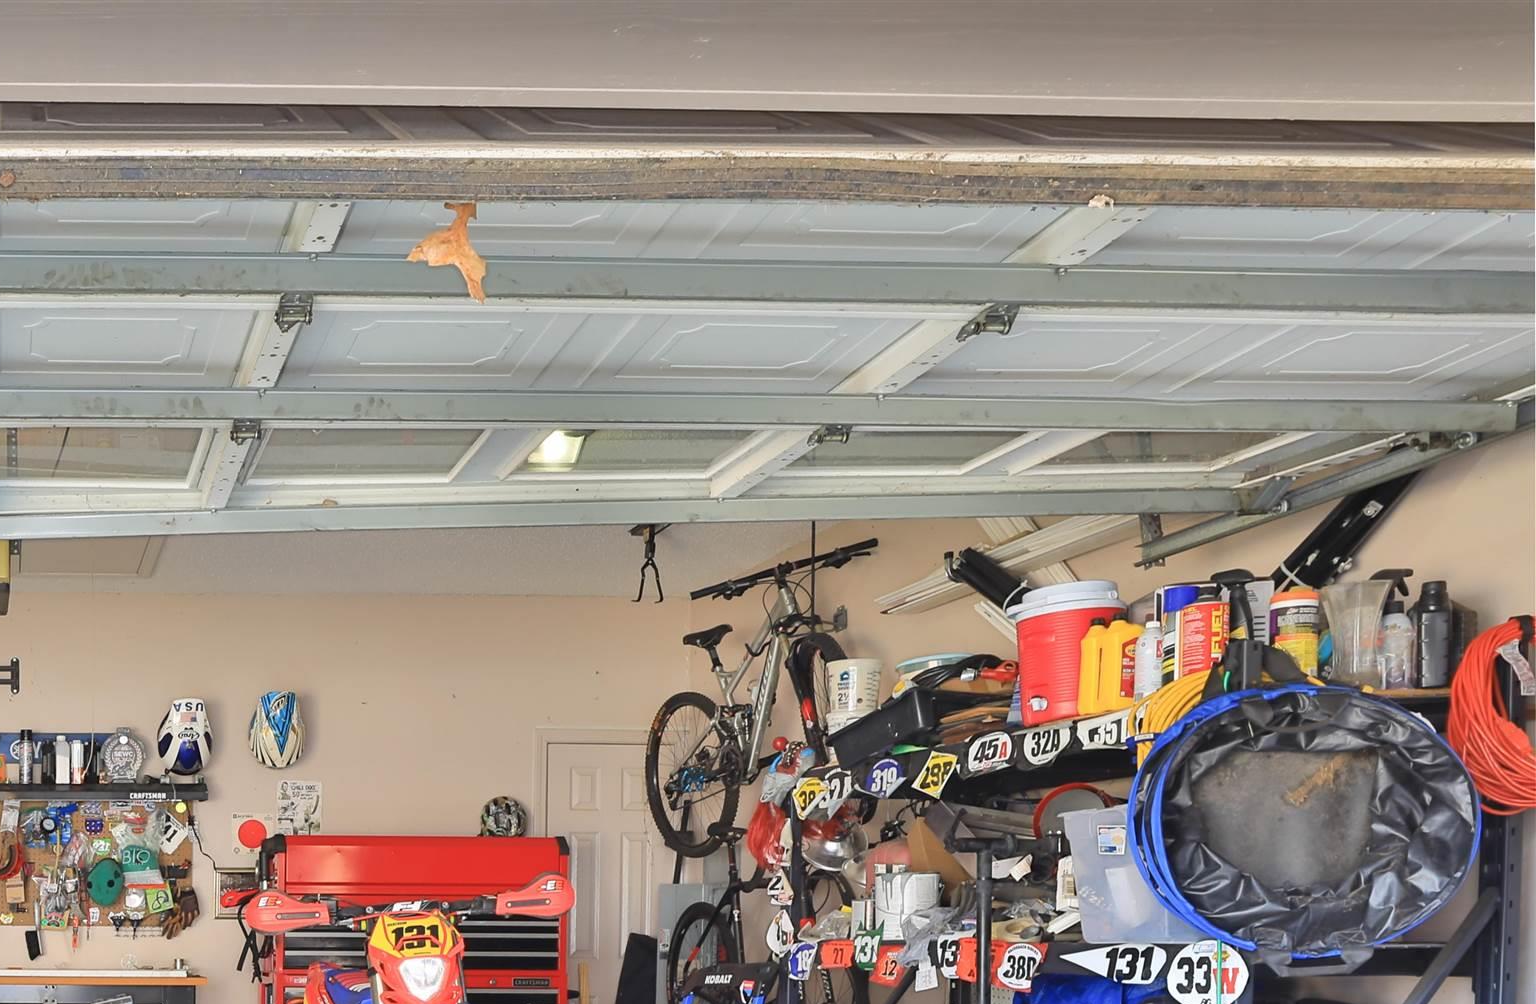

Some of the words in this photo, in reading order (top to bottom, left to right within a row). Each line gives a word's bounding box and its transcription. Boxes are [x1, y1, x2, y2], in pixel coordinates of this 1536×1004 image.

[1211, 605, 1224, 655] FUEL
[173, 702, 204, 712] USA
[1031, 728, 1061, 758] 32A
[871, 766, 898, 793] 319
[129, 792, 167, 800] CRAFTSMAN
[390, 923, 441, 951] 131
[854, 935, 881, 964] 131
[833, 948, 844, 965] 27
[939, 938, 961, 967] 13
[1105, 946, 1155, 981] 131
[704, 974, 733, 985] KOBALT
[881, 959, 898, 976] 12
